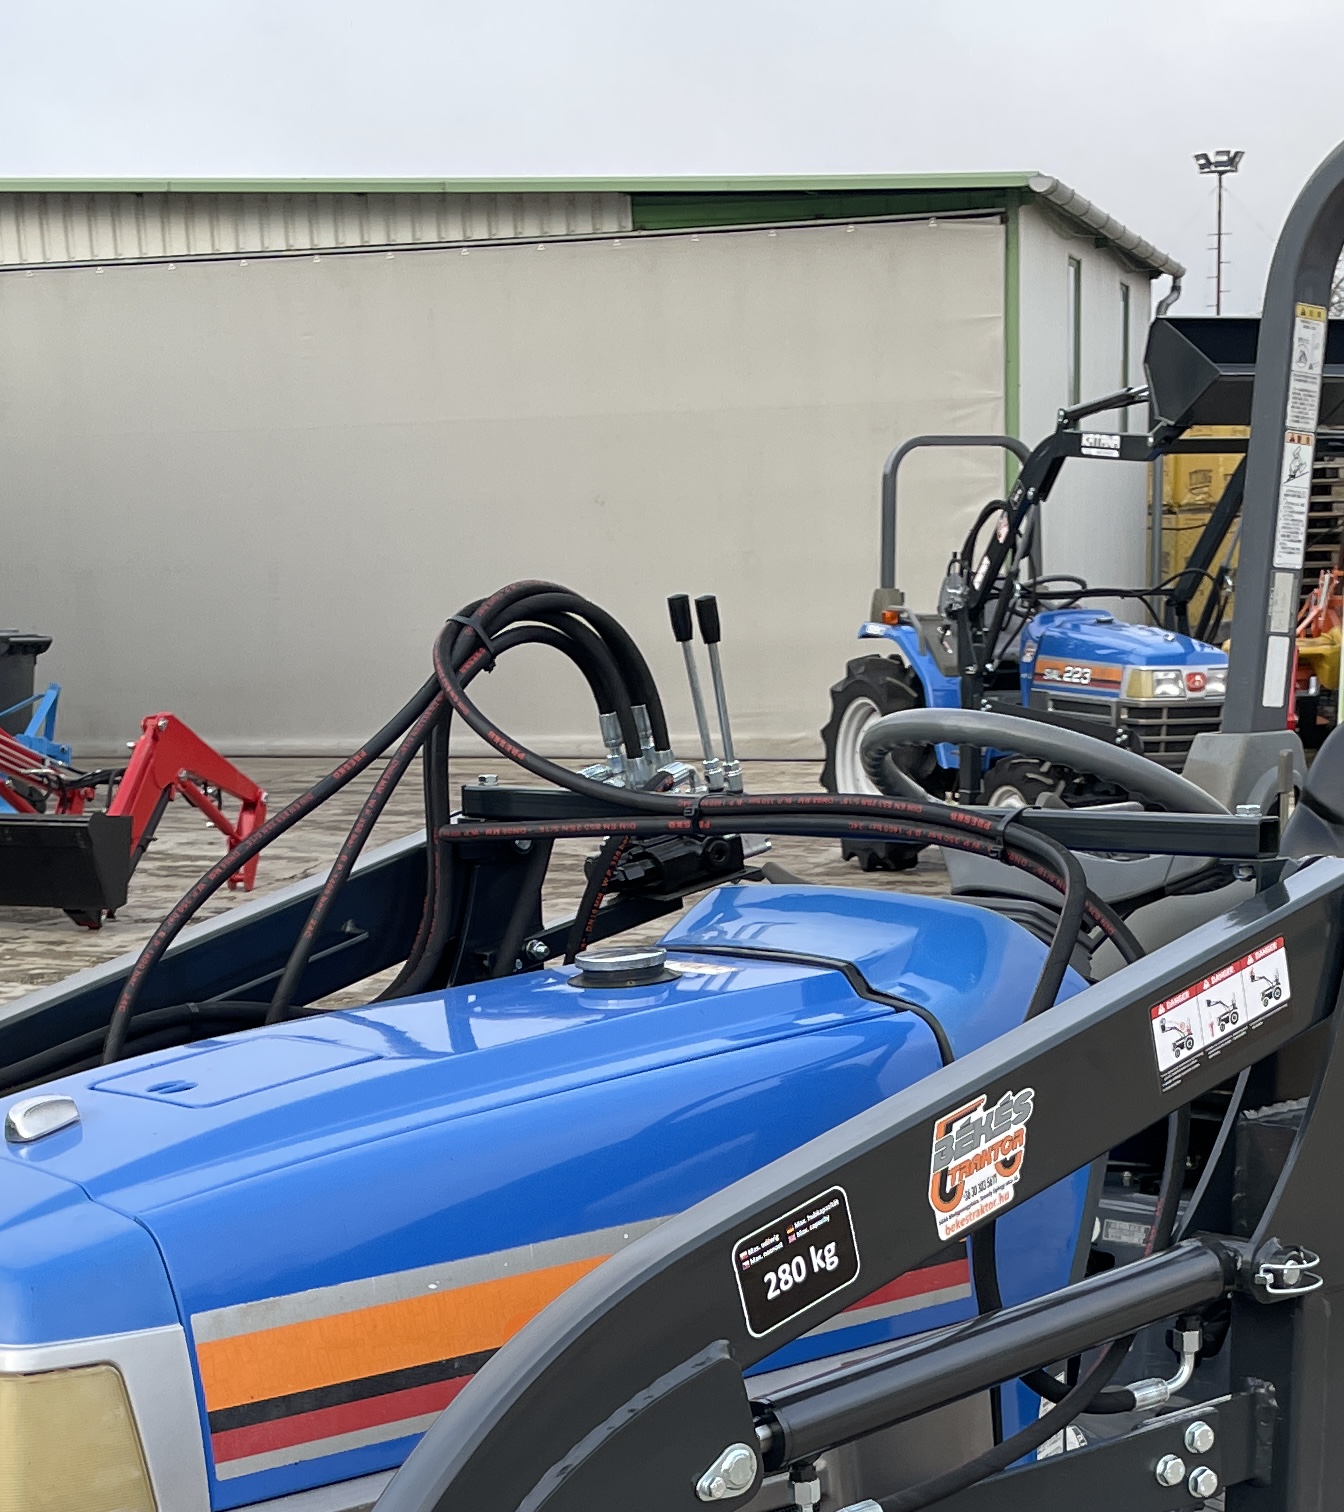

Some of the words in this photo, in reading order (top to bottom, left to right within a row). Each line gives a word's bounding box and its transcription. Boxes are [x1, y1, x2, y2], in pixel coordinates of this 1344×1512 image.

[1063, 666, 1092, 684] 223
[933, 1091, 1033, 1173] BÉKÉS
[948, 1128, 1024, 1187] TRAKTOR
[945, 1191, 1010, 1236] bekestraktor.hu
[763, 1255, 806, 1300] 280
[809, 1241, 839, 1273] kg
